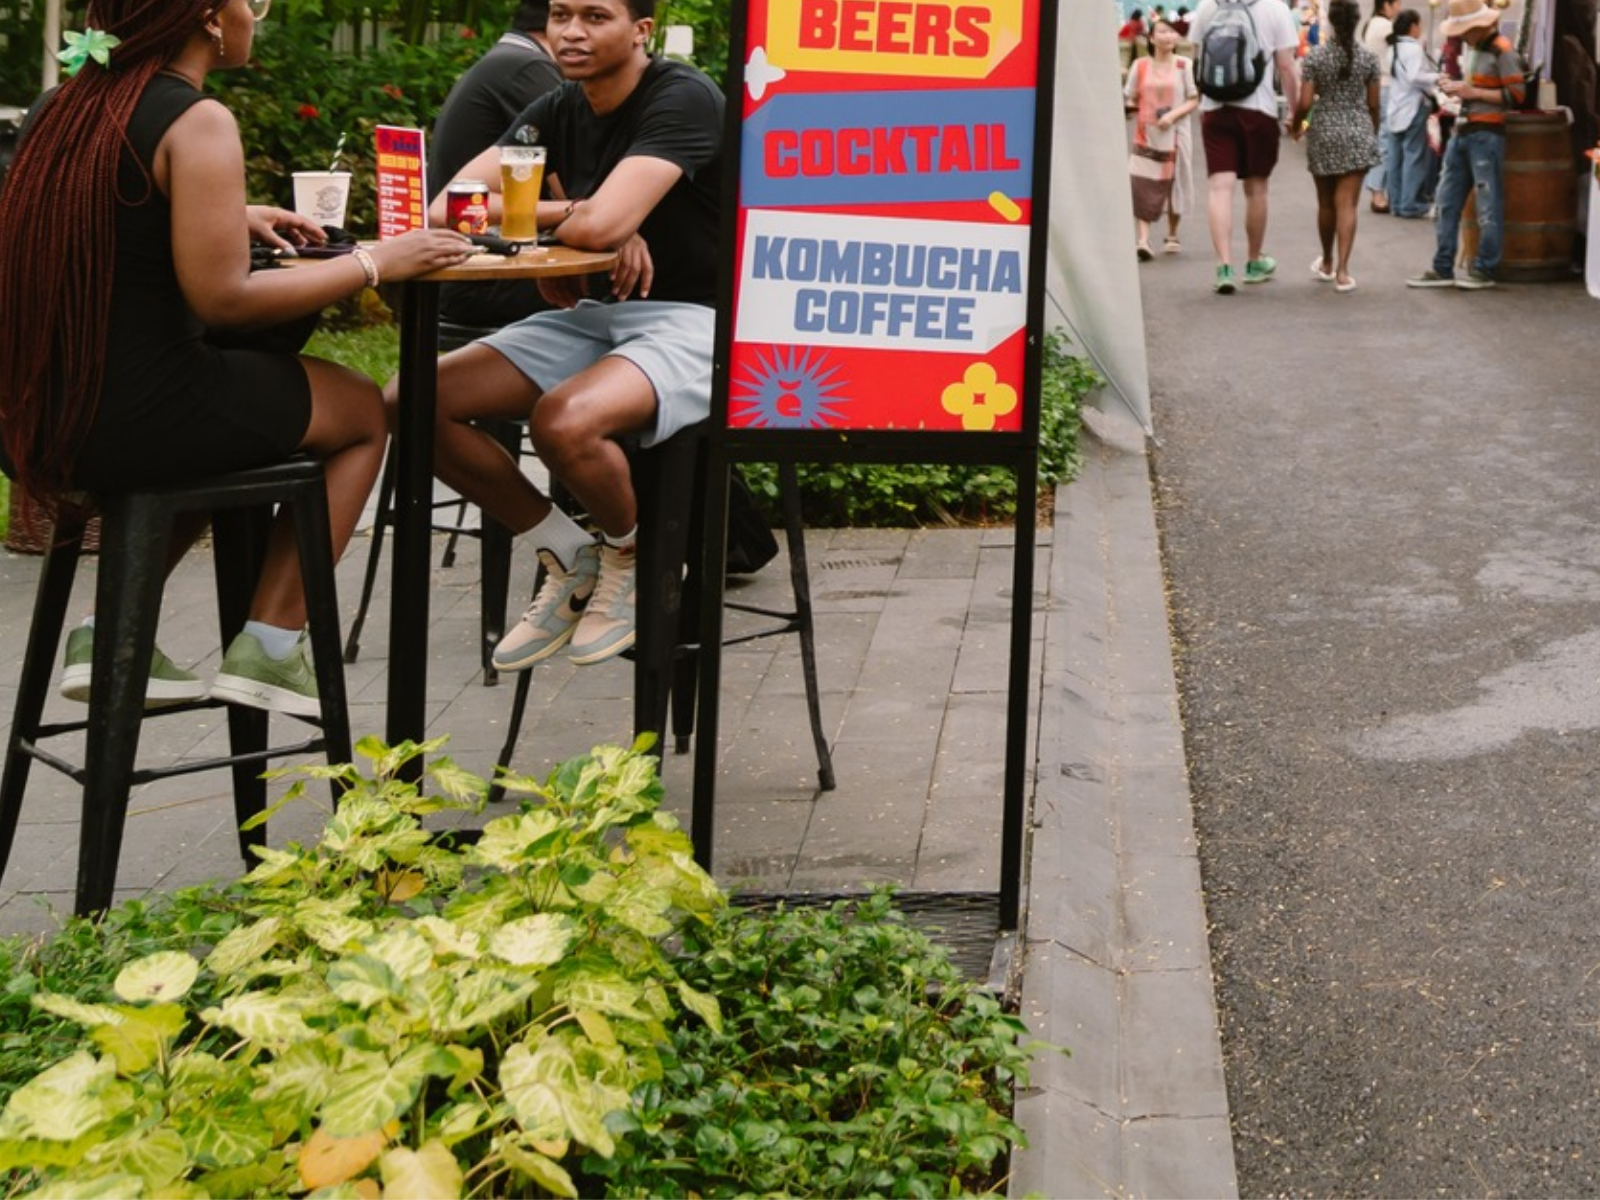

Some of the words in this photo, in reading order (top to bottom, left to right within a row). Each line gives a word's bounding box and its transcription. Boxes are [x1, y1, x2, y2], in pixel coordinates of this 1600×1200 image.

[764, 123, 1021, 178] COCKTAIL
[751, 235, 1022, 294] KOMBUCHA
[793, 288, 977, 341] COFFEE
